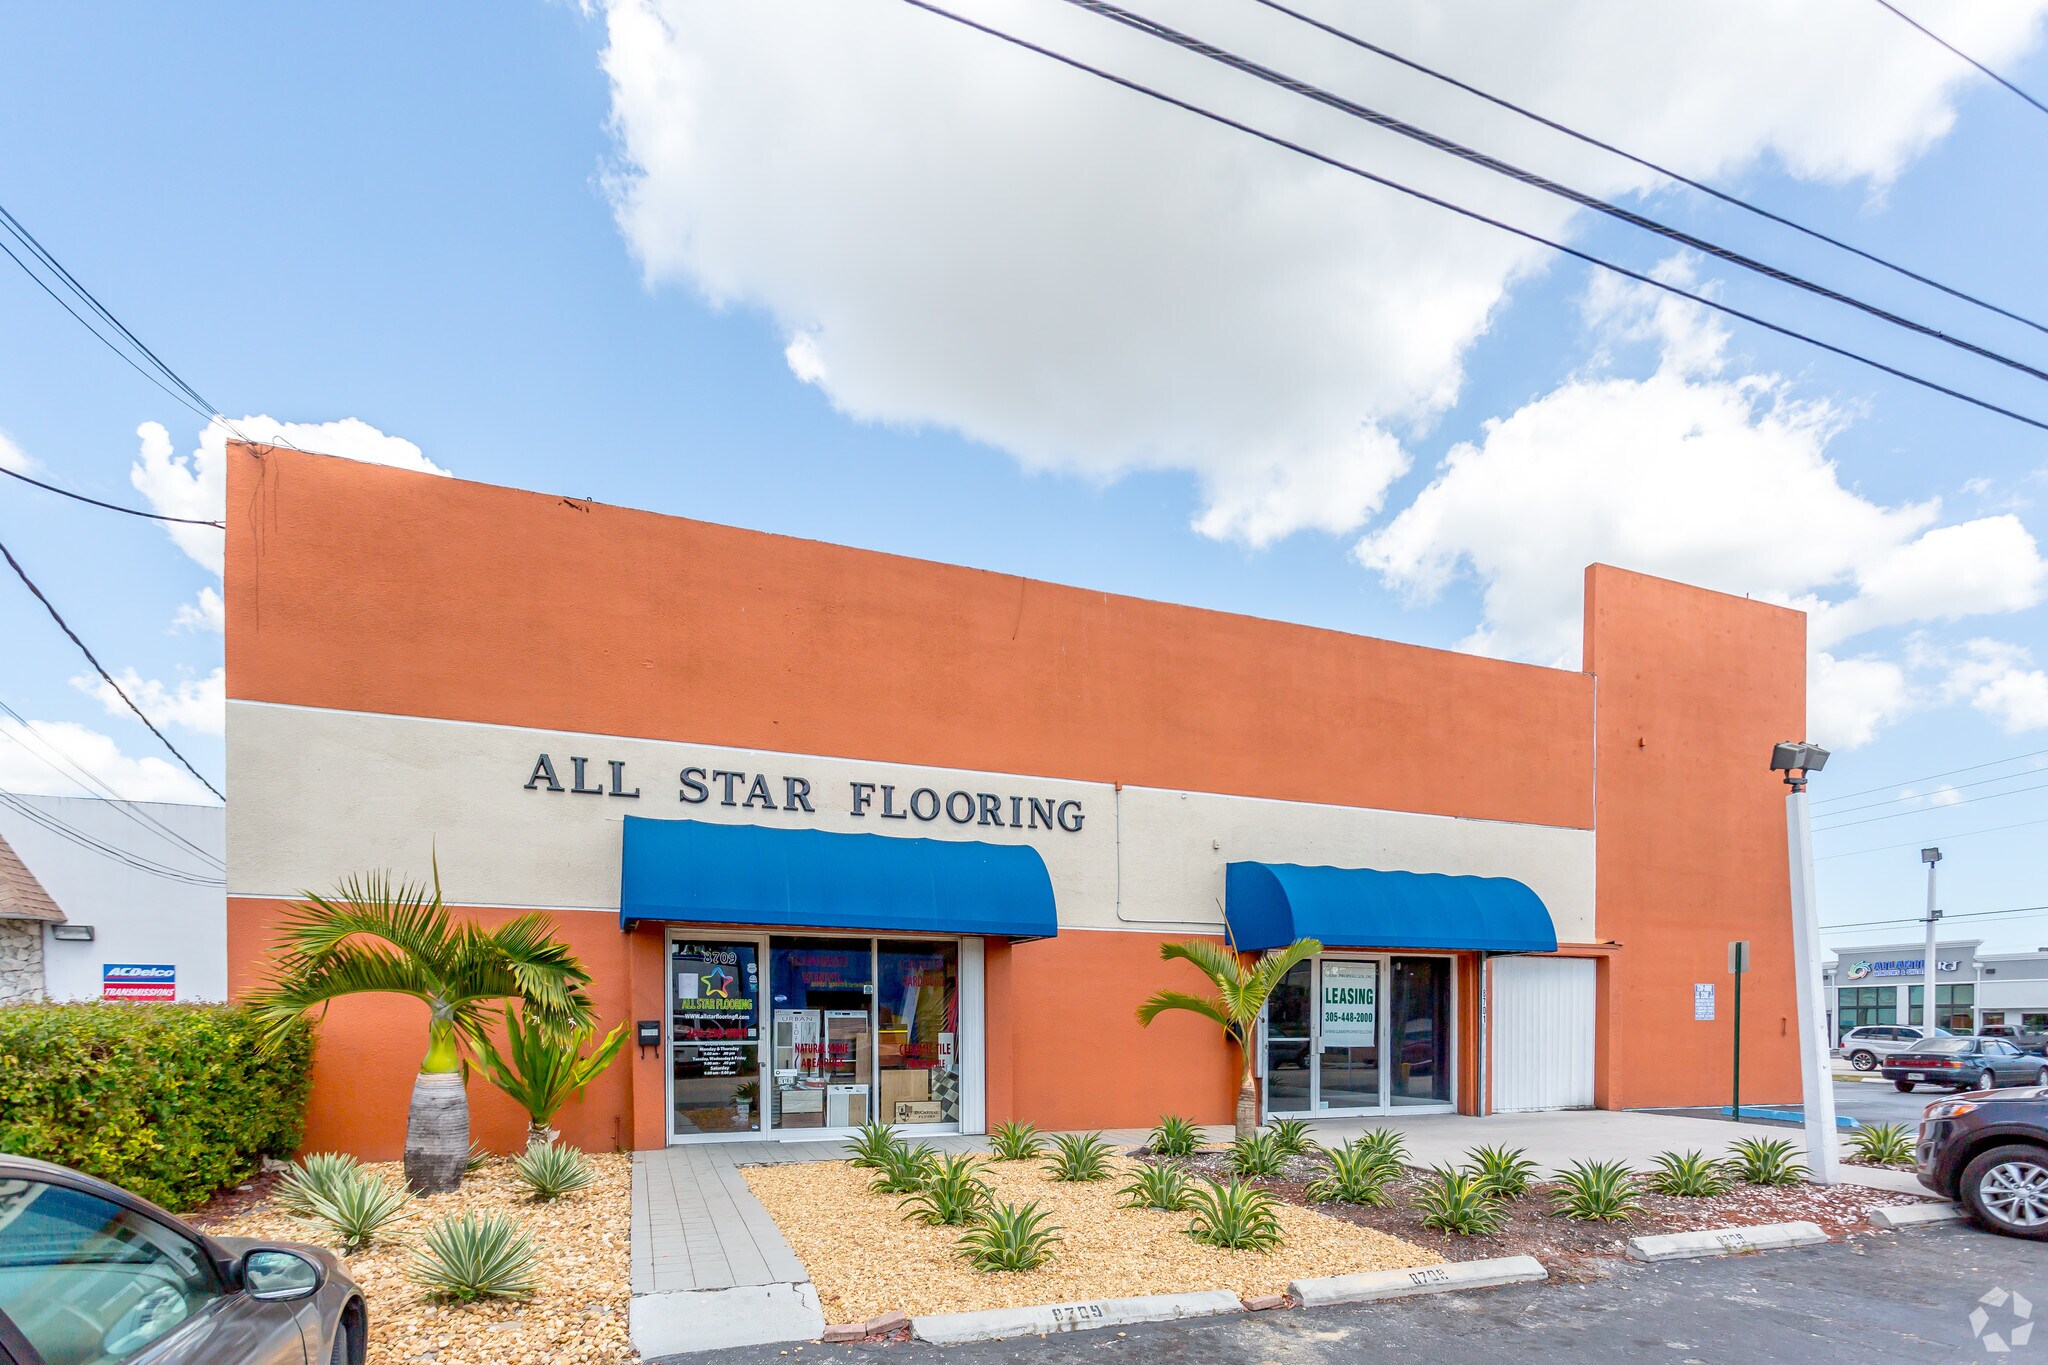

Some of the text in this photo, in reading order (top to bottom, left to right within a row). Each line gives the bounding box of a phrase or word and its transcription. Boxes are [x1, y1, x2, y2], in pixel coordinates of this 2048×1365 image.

[524, 753, 1086, 832] ALL STAR FLOORING
[703, 952, 737, 964] 8709
[1874, 960, 1925, 970] ATLANTI
[1937, 961, 1961, 972] PGT
[107, 967, 175, 977] ACDelco
[104, 988, 175, 996] TRANSMISSIONS
[1325, 988, 1373, 1005] LEASING
[682, 998, 753, 1010] ALL STAR FLOORING
[1325, 1012, 1373, 1023] 305-448-2000
[794, 1043, 825, 1053] NATURAL
[934, 1043, 951, 1055] TILE
[801, 1058, 820, 1068] AREA
